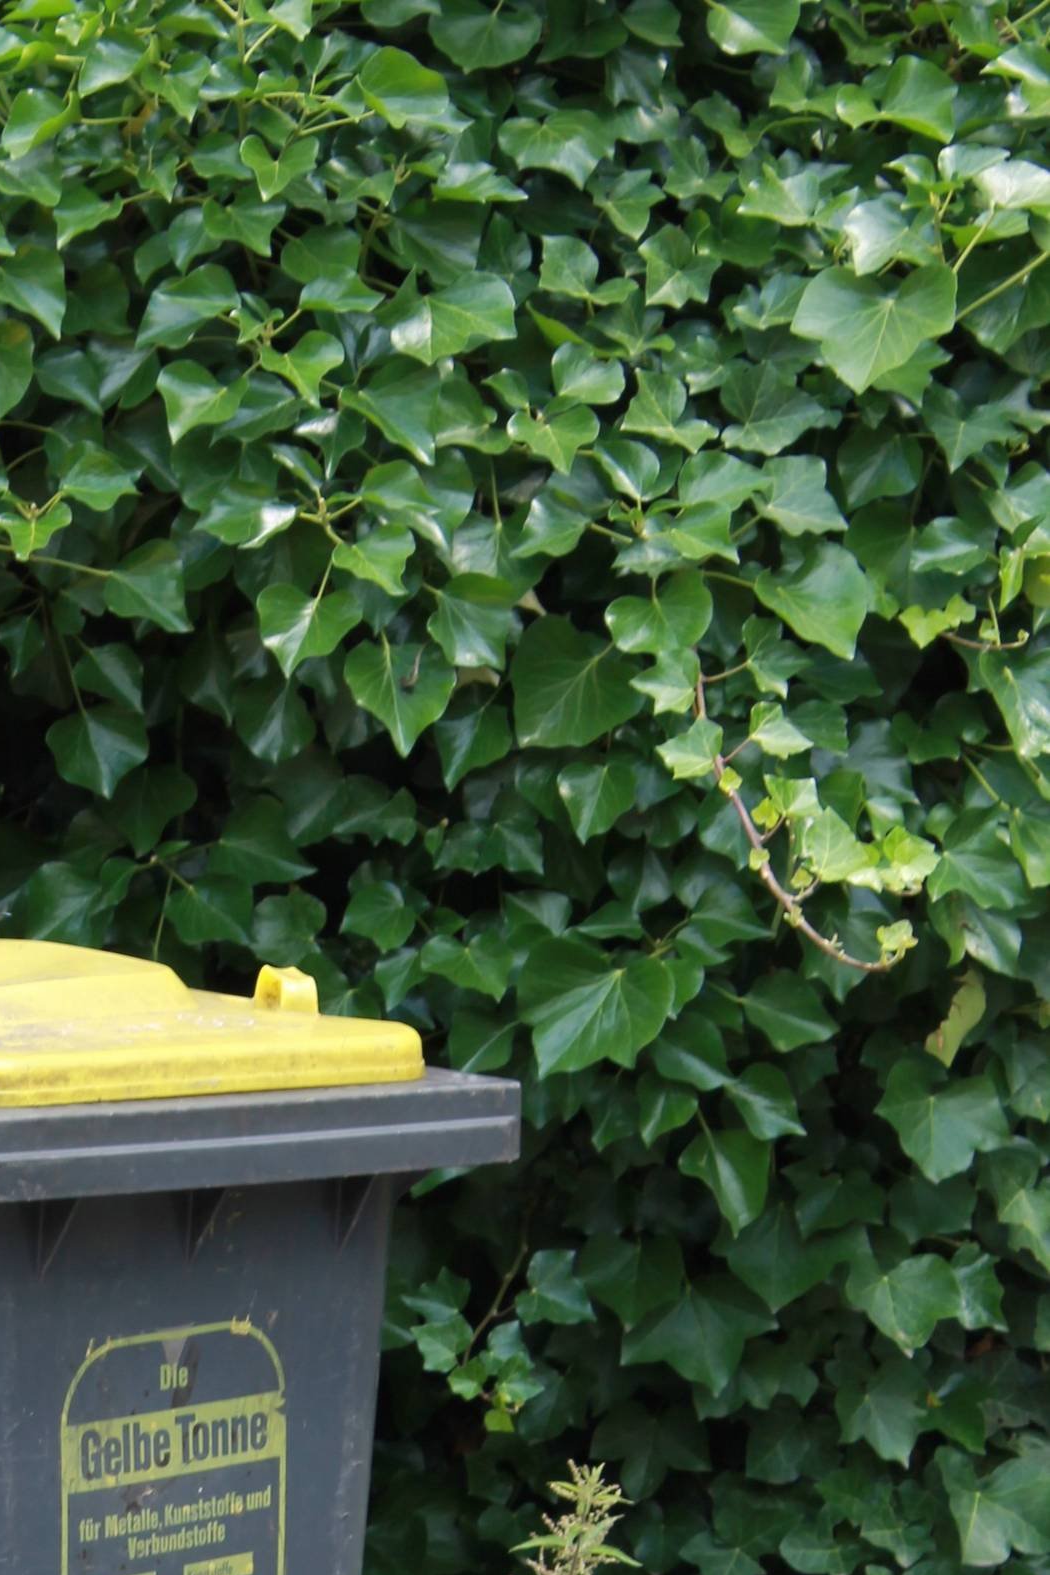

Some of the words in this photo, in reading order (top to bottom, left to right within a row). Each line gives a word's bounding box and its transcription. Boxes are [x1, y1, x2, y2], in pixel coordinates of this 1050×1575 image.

[160, 1363, 188, 1390] Die
[80, 1420, 170, 1482] Gelbe
[175, 1411, 268, 1464] Tonne
[79, 1518, 101, 1543] für
[105, 1508, 162, 1538] Metalle,
[165, 1493, 243, 1526] Kunststoffe
[246, 1485, 271, 1508] und
[128, 1521, 226, 1560] Verbundstoffe
